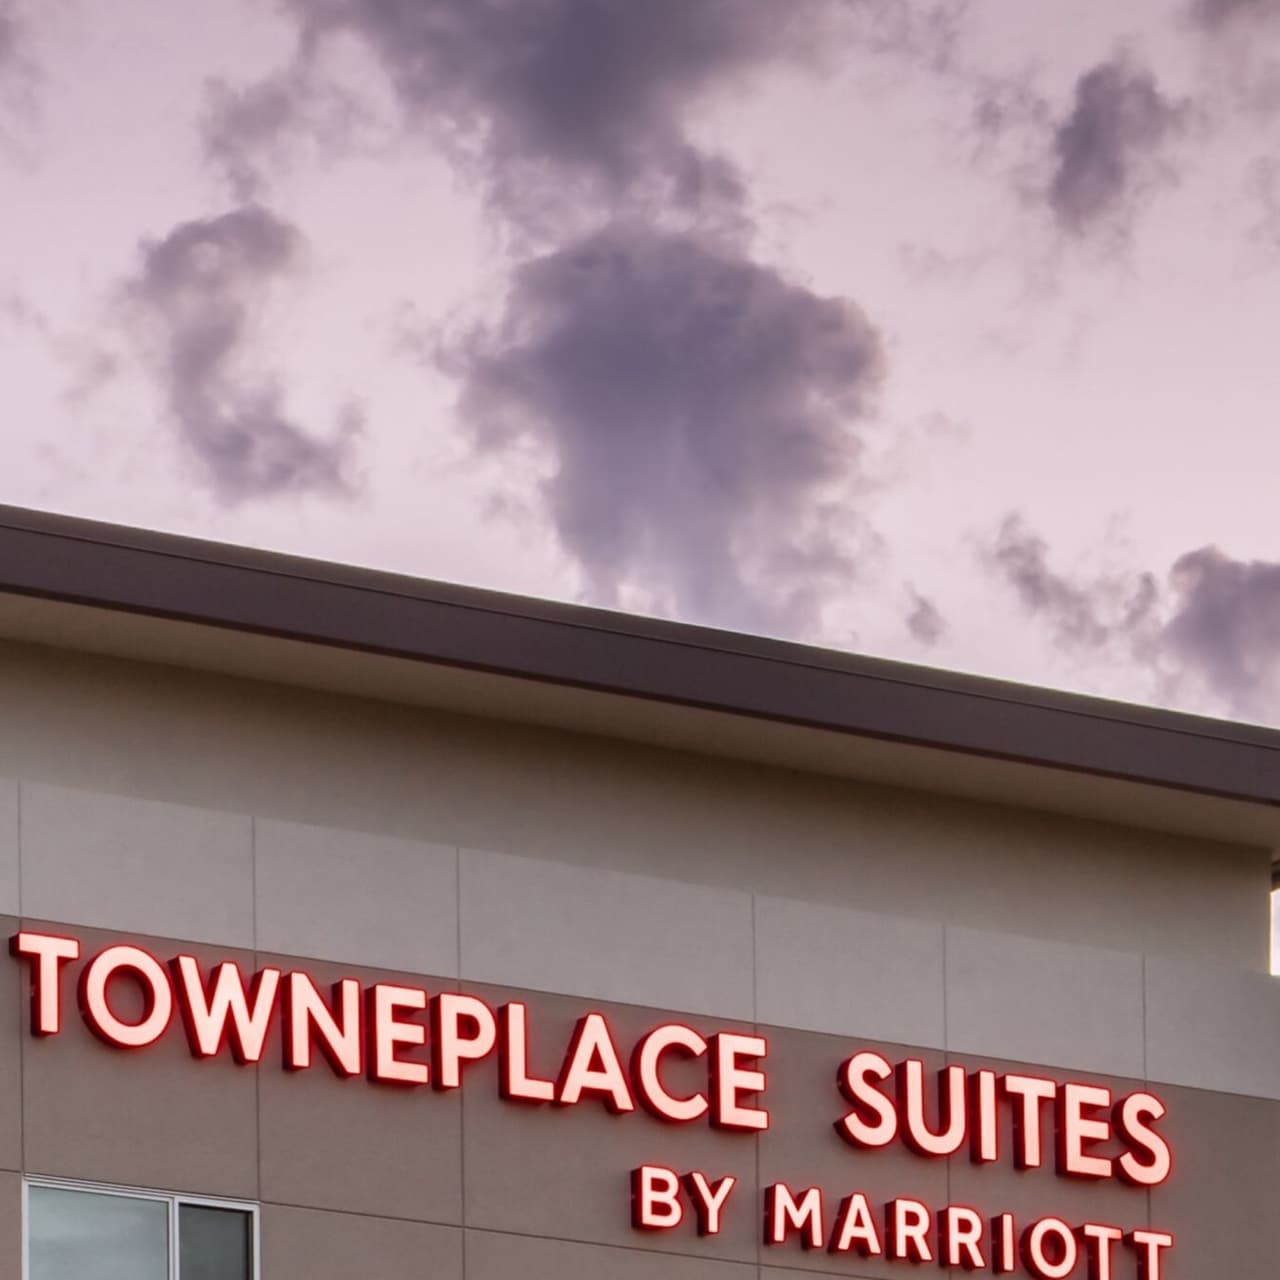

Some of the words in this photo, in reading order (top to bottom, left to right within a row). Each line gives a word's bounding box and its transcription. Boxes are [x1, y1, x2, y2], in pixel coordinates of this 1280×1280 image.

[13, 931, 771, 1133] TOWNEPLACE
[841, 1049, 1174, 1189] SUITES
[639, 1163, 738, 1237] BY
